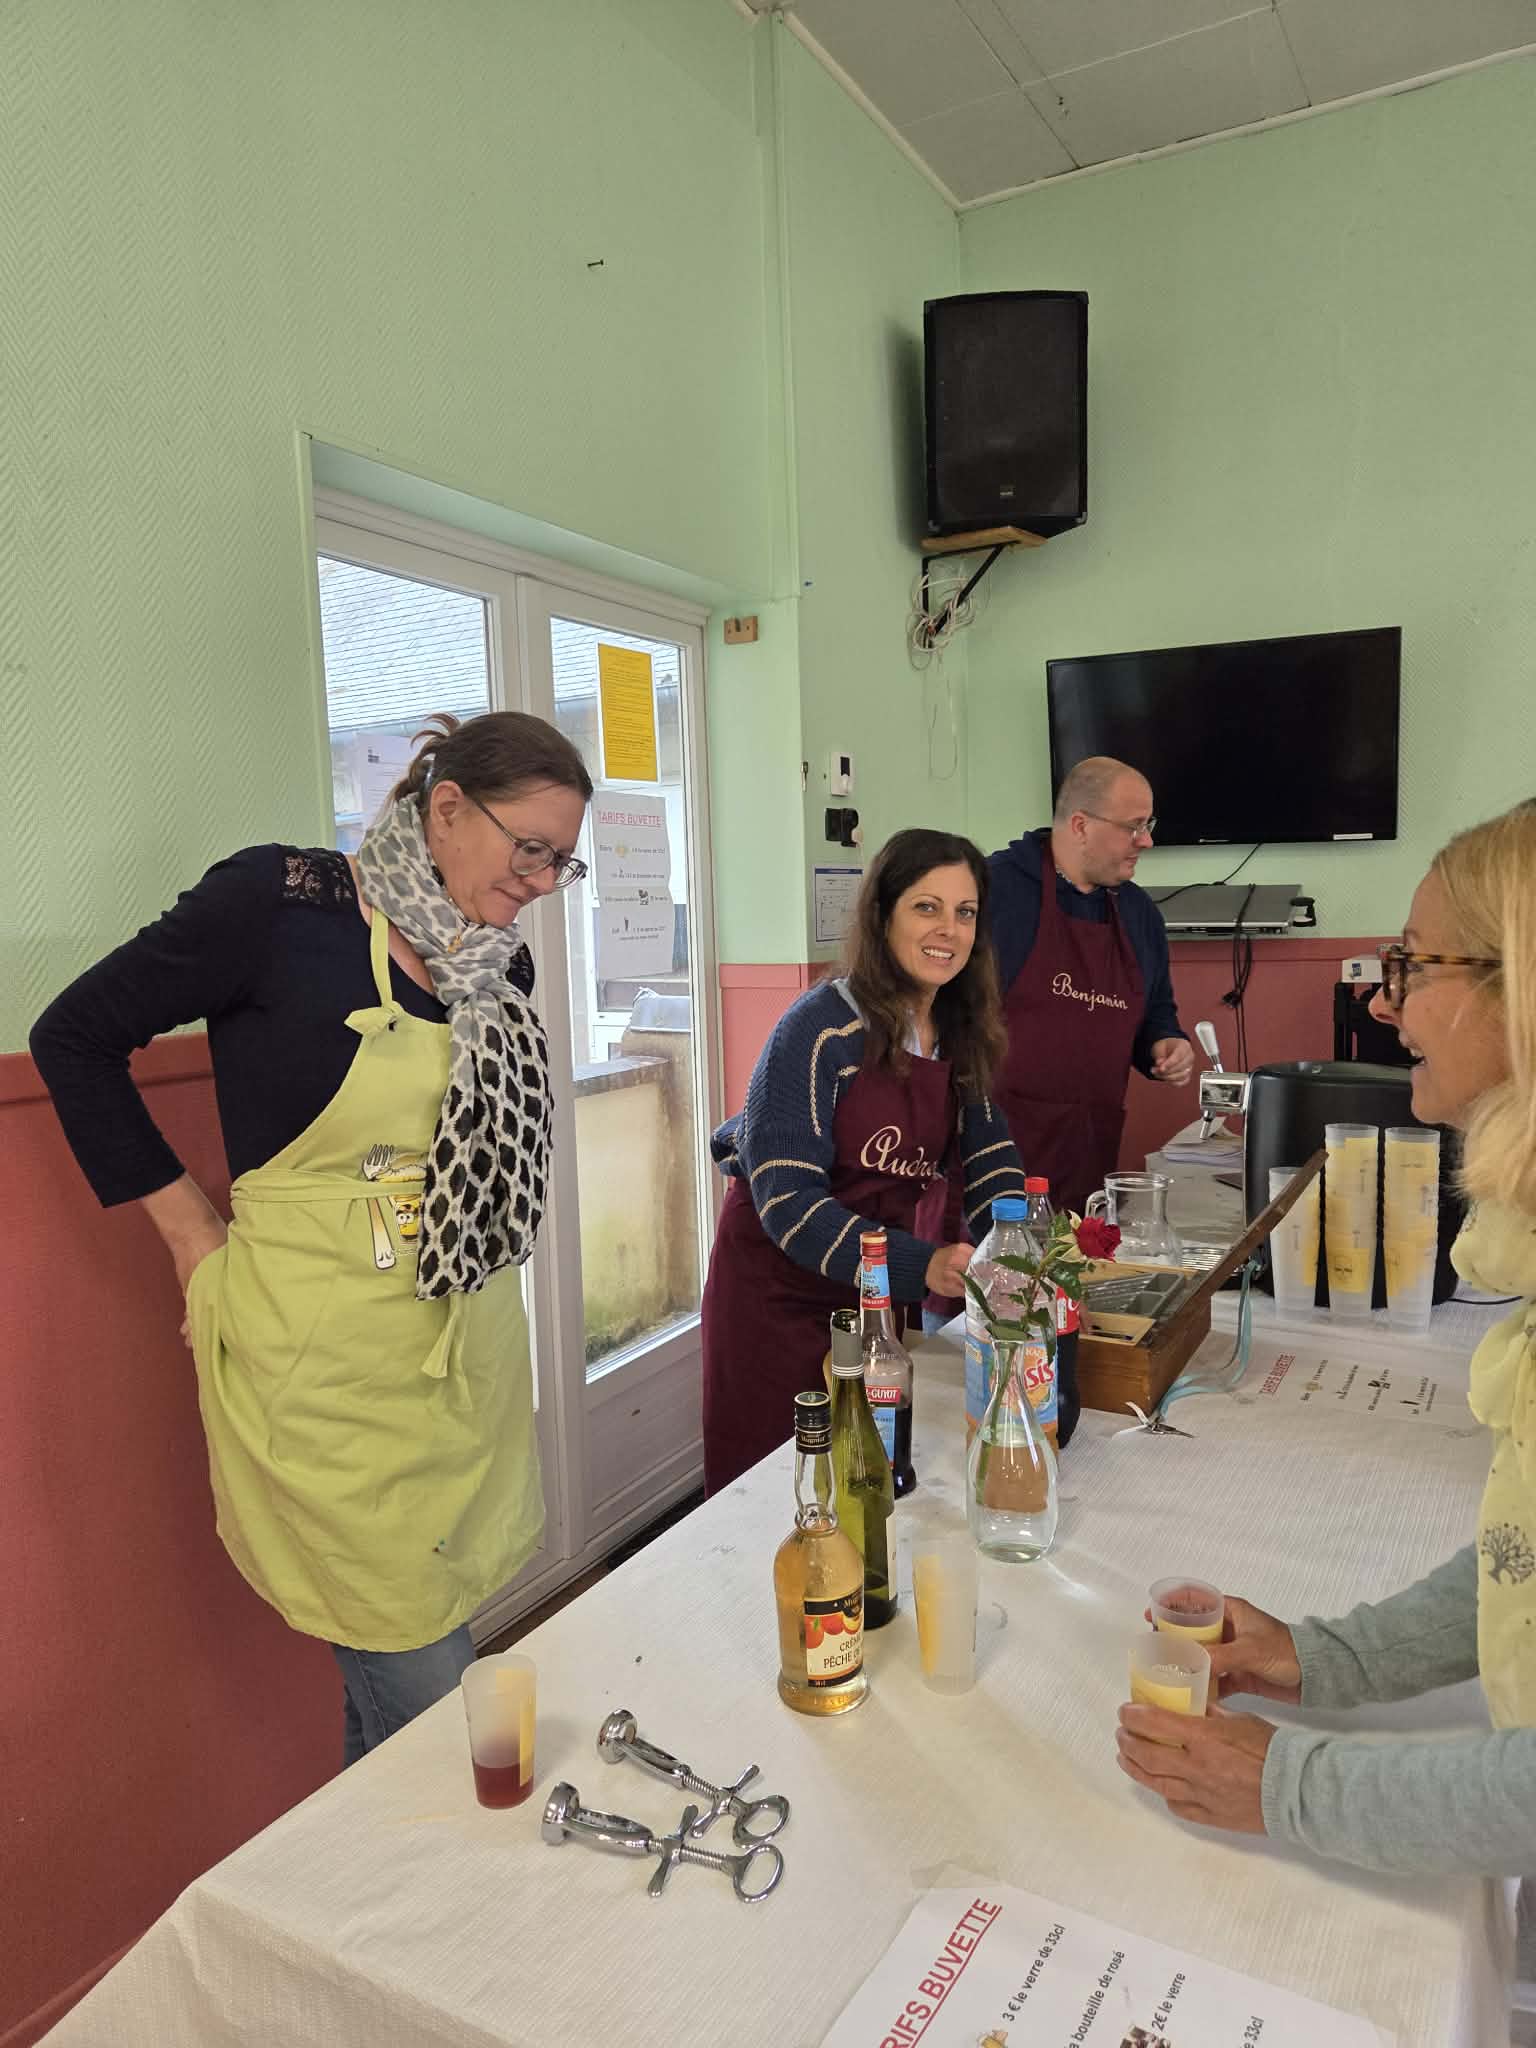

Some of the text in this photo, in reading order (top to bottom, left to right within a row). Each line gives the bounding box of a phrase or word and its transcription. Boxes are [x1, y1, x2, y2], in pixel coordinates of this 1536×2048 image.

[1052, 972, 1128, 1011] Benjamin
[1045, 1923, 1066, 1945] 33cl
[1039, 1945, 1053, 1959] de
[879, 1898, 999, 2048] RIFS BUVETTE
[1022, 1958, 1044, 1989] verre
[1071, 1990, 1104, 2041] bouteille
[1098, 1974, 1113, 1988] de
[1107, 1950, 1125, 1974] rosé
[1152, 1972, 1186, 2031] 2€ le verre
[1244, 2016, 1264, 2041] 33cl
